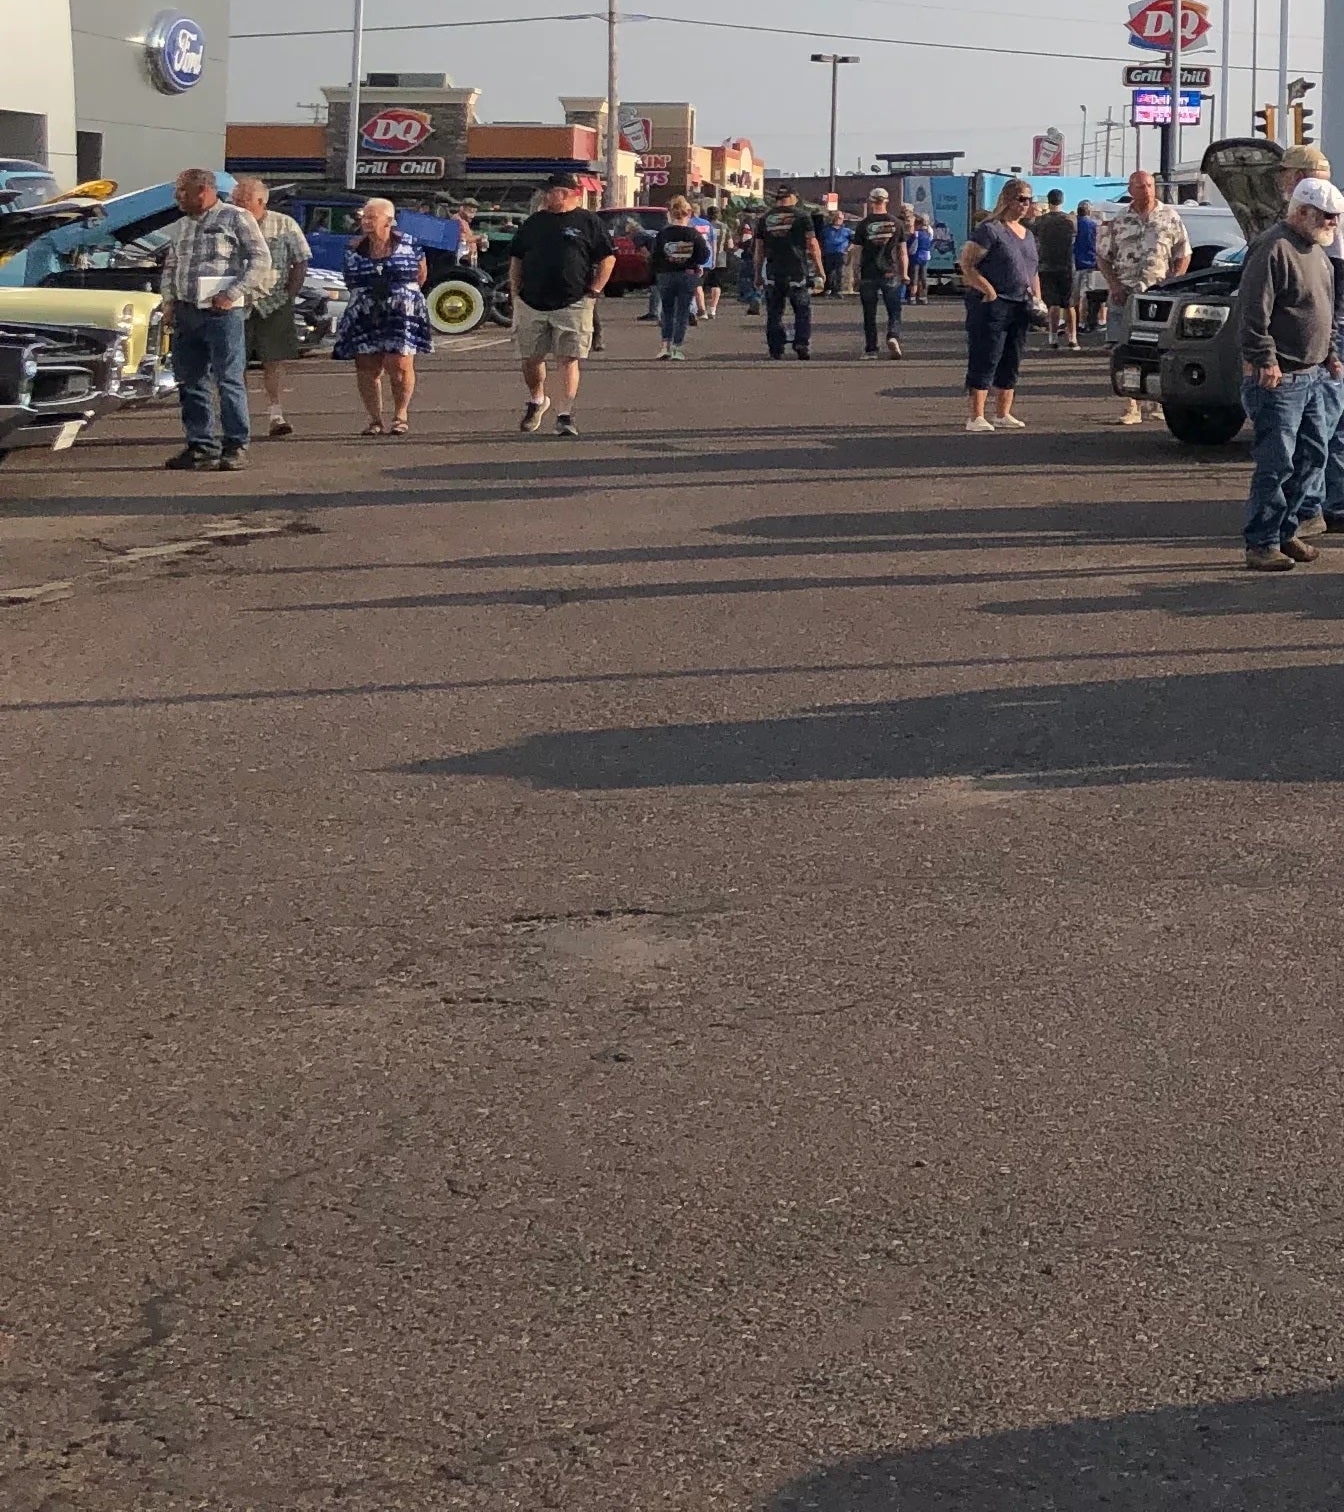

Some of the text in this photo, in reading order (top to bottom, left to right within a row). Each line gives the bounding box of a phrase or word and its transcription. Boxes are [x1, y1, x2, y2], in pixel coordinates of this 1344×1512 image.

[1143, 10, 1198, 39] DQ
[174, 28, 203, 76] Ford
[1130, 70, 1162, 82] Grill
[373, 119, 421, 144] DQ
[356, 161, 389, 174] Grill
[400, 161, 437, 174] Chill
